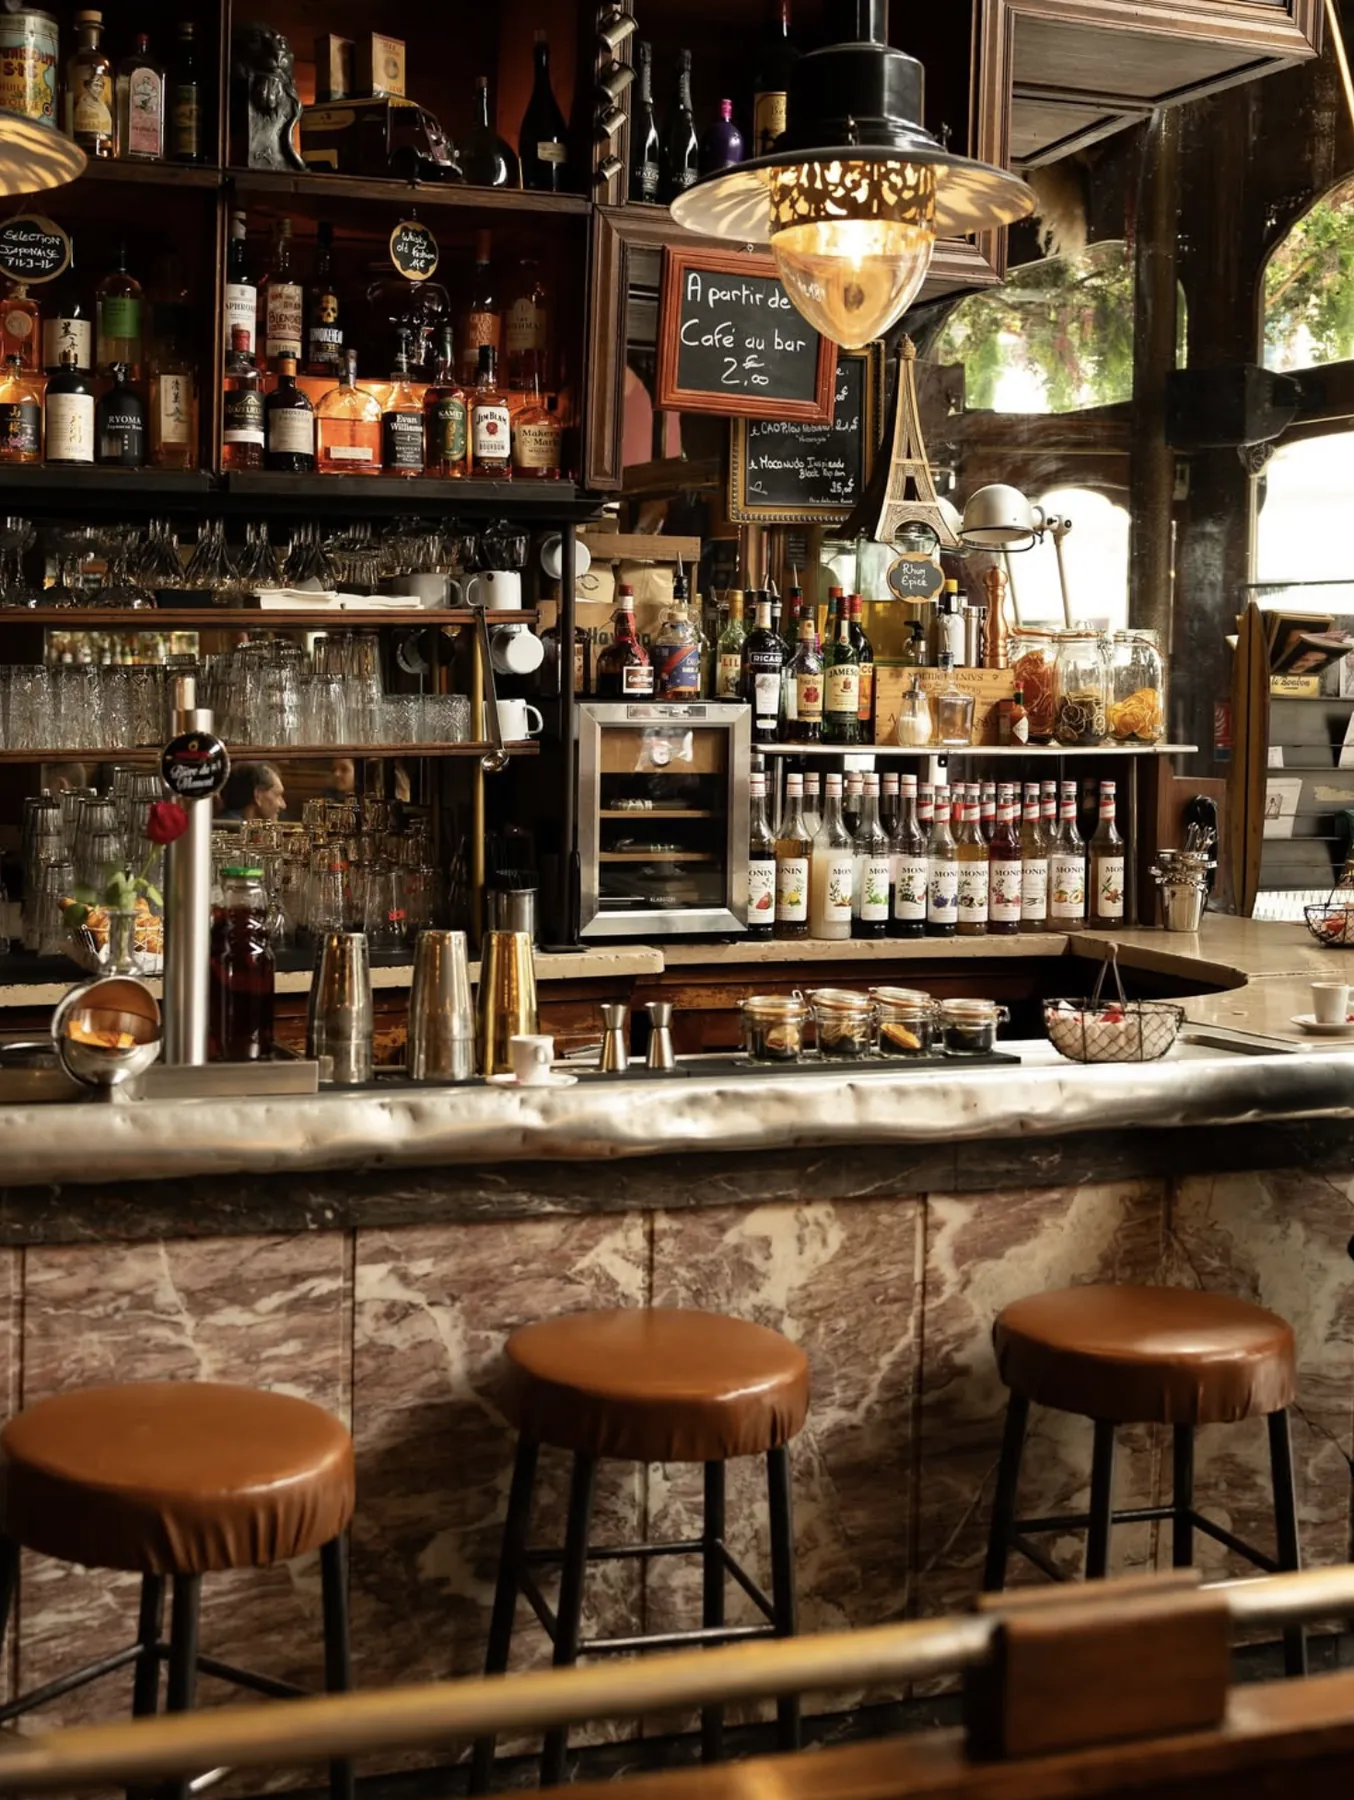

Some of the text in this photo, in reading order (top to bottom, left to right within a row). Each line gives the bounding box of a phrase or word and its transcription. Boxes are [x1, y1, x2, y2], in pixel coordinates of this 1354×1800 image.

[687, 273, 791, 309] A partir de
[680, 319, 806, 351] Café au bar
[108, 415, 142, 425] RYOMA
[396, 414, 418, 424] Evan
[903, 563, 925, 575] Rhum
[722, 657, 739, 667] LIL
[829, 668, 858, 678] JAMES
[748, 869, 773, 877] ONIN
[779, 867, 802, 875] ONIN
[869, 867, 888, 875] MON
